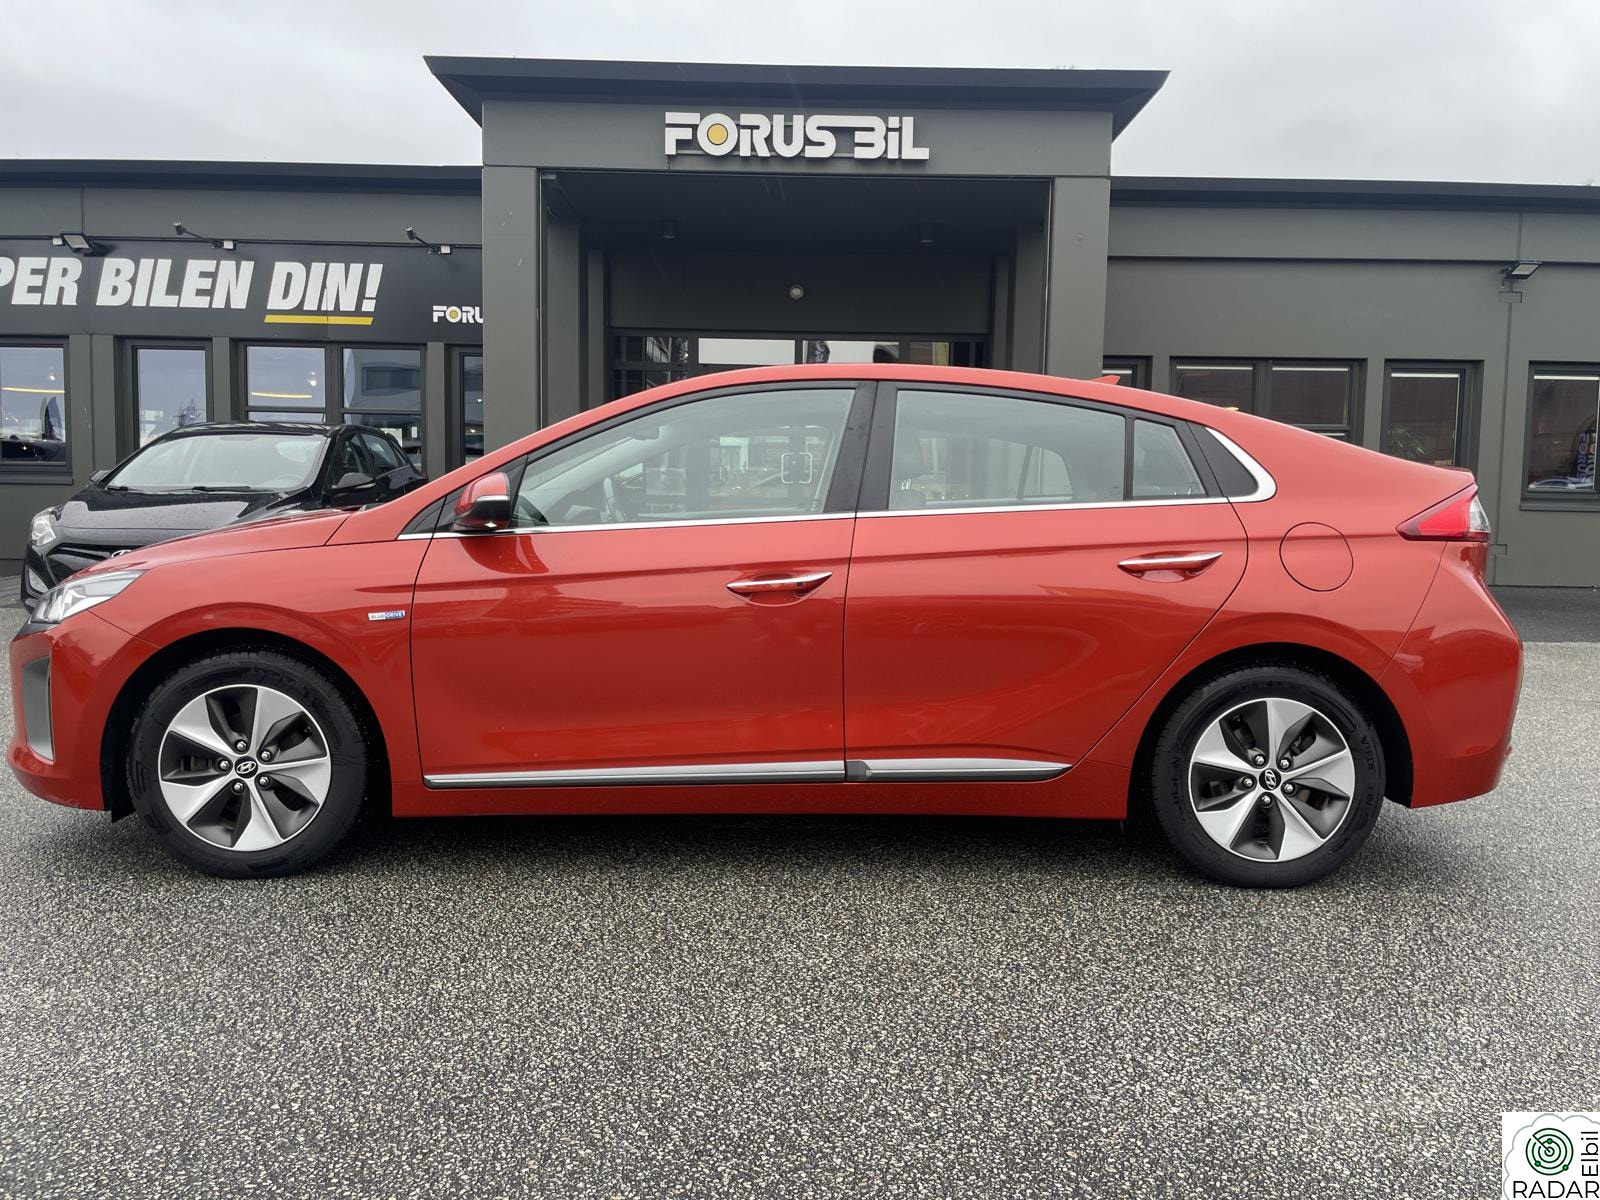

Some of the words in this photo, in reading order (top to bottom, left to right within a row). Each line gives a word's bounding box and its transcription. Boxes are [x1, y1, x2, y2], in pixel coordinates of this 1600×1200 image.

[665, 111, 837, 158] FORUS
[96, 257, 255, 309] BILEN
[266, 261, 384, 312] DIN!
